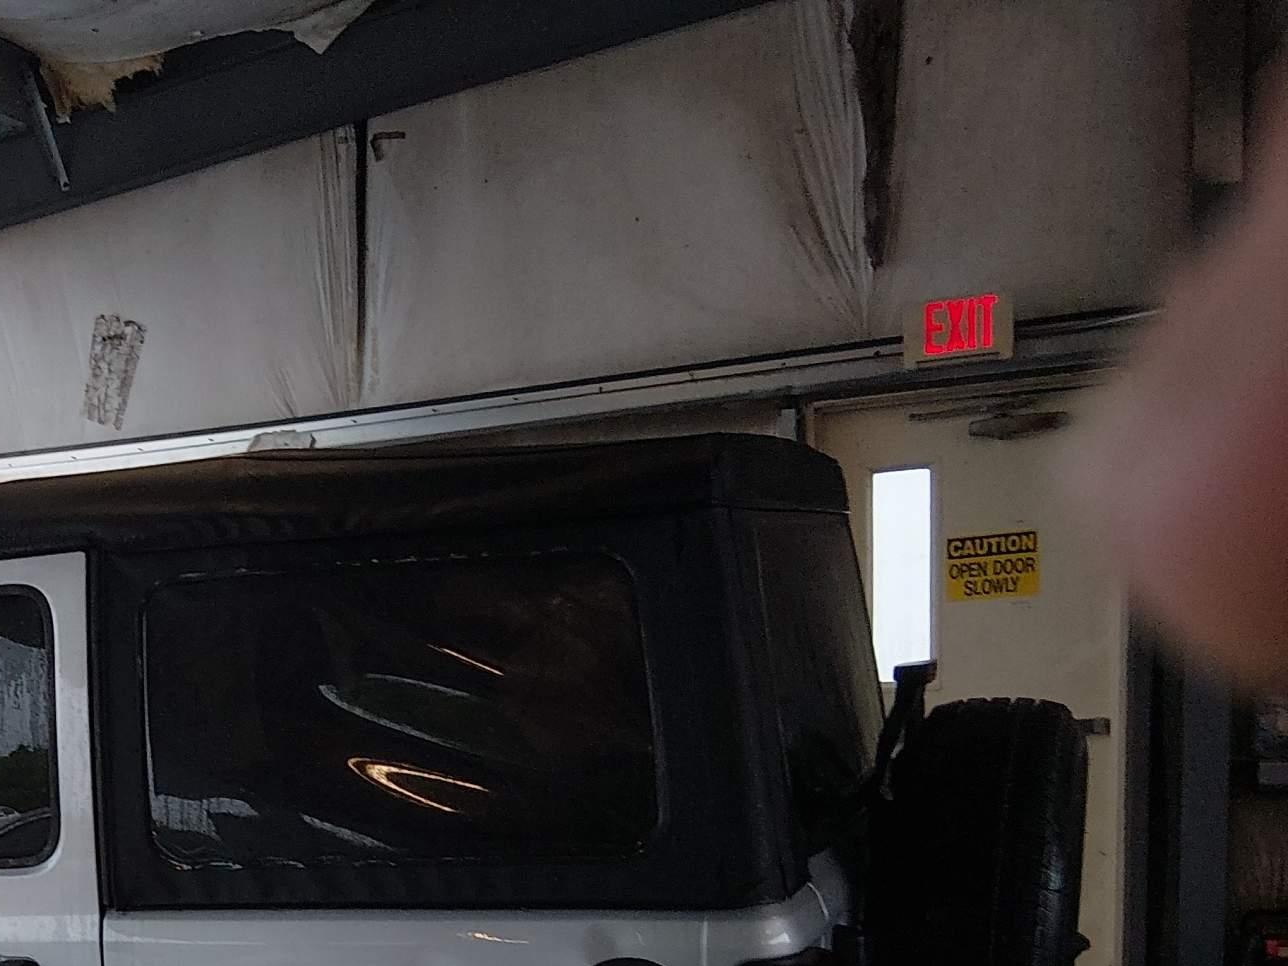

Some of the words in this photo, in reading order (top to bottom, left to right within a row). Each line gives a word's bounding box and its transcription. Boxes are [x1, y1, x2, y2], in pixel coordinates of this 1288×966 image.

[924, 293, 998, 356] EXIT
[949, 534, 1035, 557] CAUTION
[949, 561, 988, 580] OPEN
[993, 557, 1035, 576] DOOR
[963, 576, 1019, 596] SLOWLY
